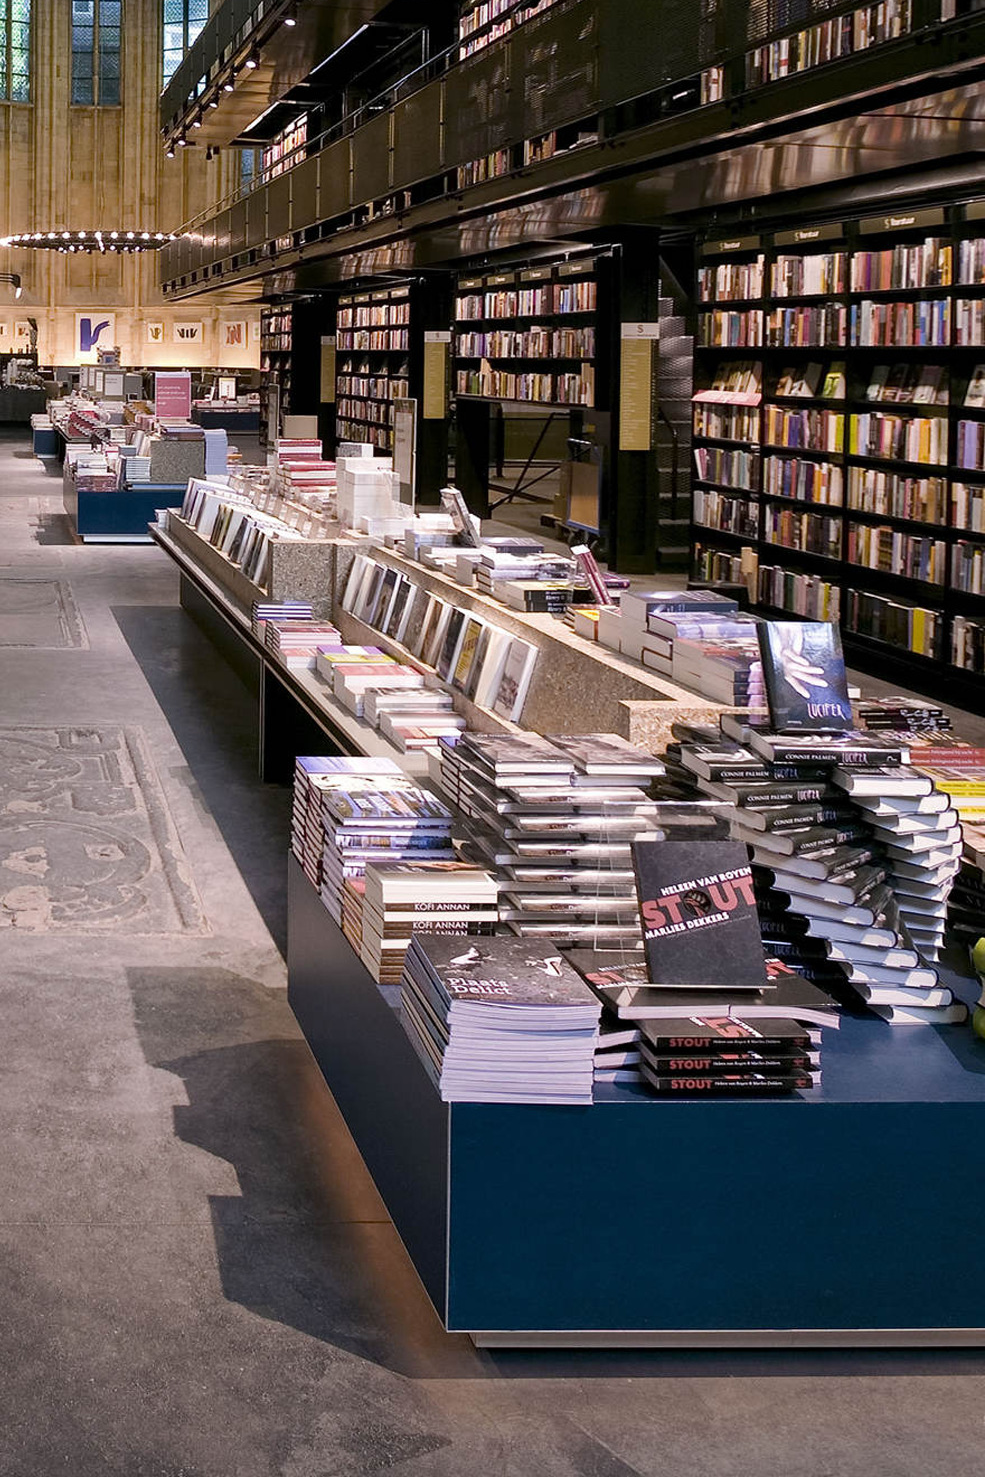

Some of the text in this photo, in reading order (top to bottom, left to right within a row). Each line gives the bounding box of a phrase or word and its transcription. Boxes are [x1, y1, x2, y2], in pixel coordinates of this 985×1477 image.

[807, 702, 847, 721] LUCIFER
[785, 753, 810, 761] CONNIE
[811, 754, 837, 762] PALMEN
[720, 770, 745, 778] CONNIE
[746, 770, 769, 778] PALMEN
[771, 793, 794, 801] PALMEN
[698, 874, 718, 888] VAN
[719, 865, 752, 883] ROYEN
[415, 903, 470, 911] KOFI ANNAN
[412, 921, 469, 929] KOFI ANNAN
[645, 911, 730, 940] MARLIES DEKKERS
[447, 977, 509, 988] Plaats
[453, 986, 512, 995] Delict
[669, 1038, 711, 1047] STOUT
[669, 1059, 711, 1069] STOUT
[671, 1079, 713, 1089] STOUT
